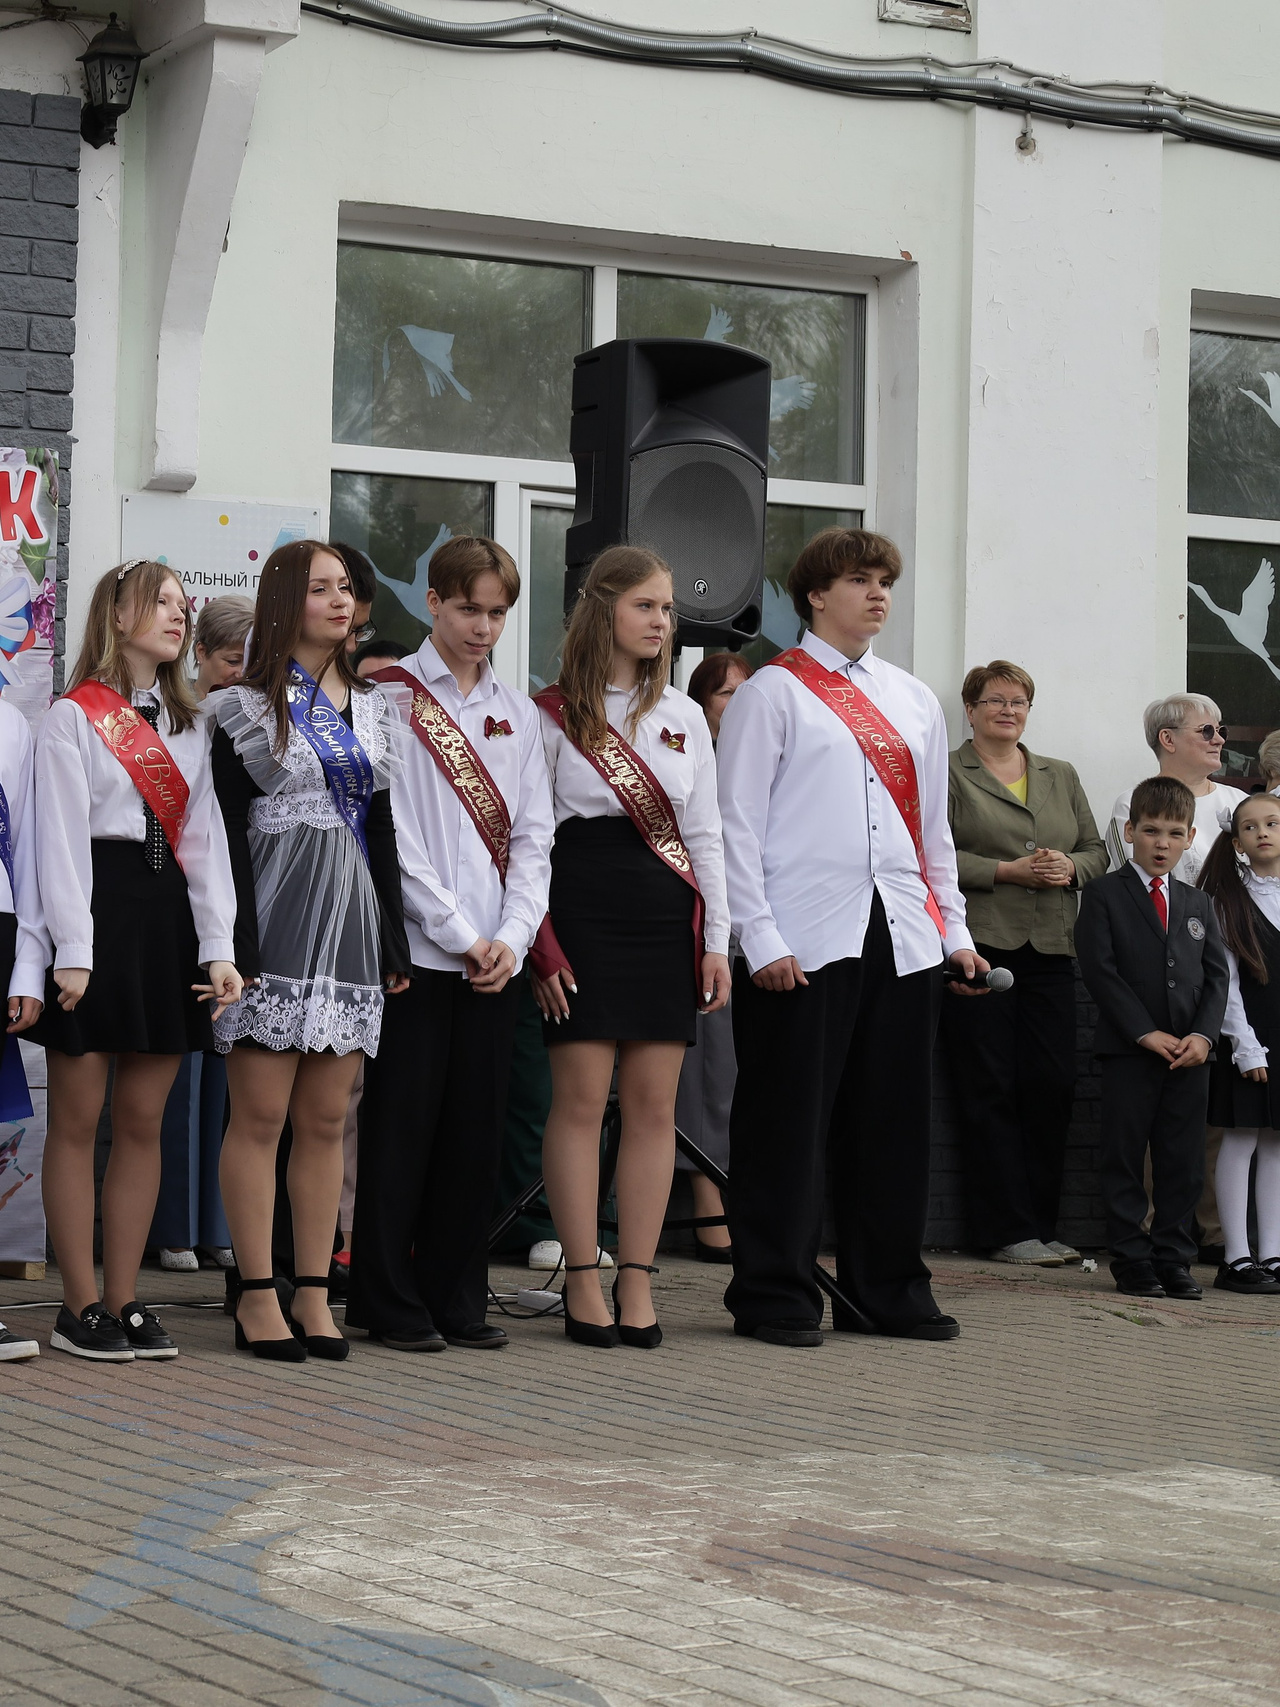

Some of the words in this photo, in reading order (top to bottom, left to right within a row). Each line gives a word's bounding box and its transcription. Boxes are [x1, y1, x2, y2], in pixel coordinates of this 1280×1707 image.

[431, 725, 503, 837] Выпускник
[818, 677, 908, 786] Выпускник
[649, 820, 691, 873] 2025
